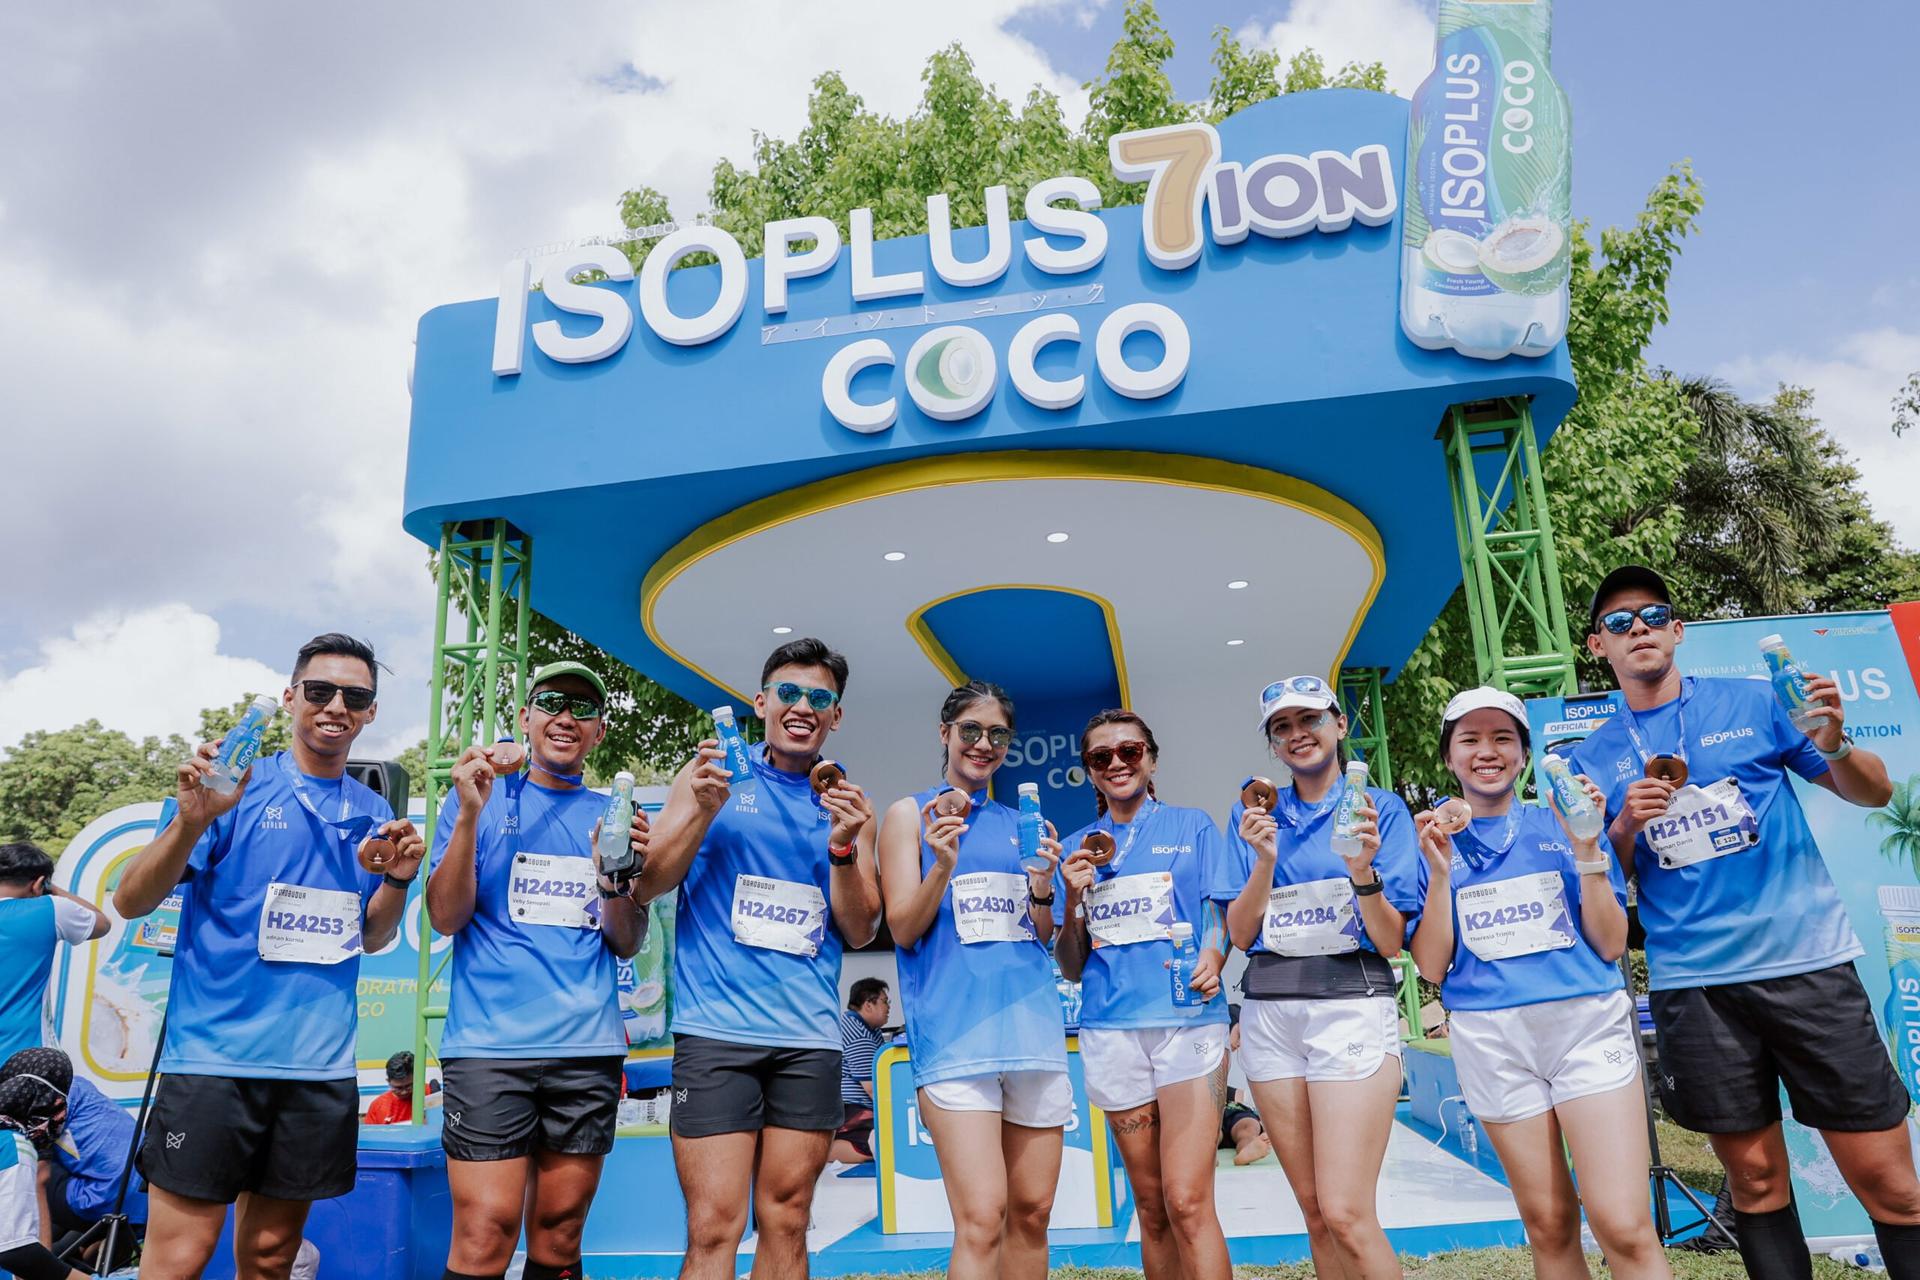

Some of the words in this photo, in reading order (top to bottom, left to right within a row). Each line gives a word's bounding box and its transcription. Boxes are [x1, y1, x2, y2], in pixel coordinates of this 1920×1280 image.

[1502, 60, 1535, 154] COCO
[1440, 53, 1486, 218] ISOPLUS
[492, 177, 1108, 376] ISOPLUS
[822, 303, 1190, 433] COCO
[1565, 703, 1617, 719] ISOPLUS
[1550, 722, 1589, 732] OFFICIAL
[1701, 727, 1754, 748] ISOPLUS
[1844, 724, 1903, 739] RATION
[729, 736, 749, 776] ISOPLUS
[1003, 734, 1082, 768] SOPL
[1649, 803, 1729, 841] H21151
[513, 877, 586, 899] H24232
[1460, 887, 1497, 900] BOROBUDUR
[738, 899, 810, 926] H24267
[958, 896, 1015, 914] K24320
[1089, 896, 1153, 922] K24273
[1269, 906, 1337, 929] K24284
[1464, 901, 1545, 932] K24259
[267, 910, 344, 936] H24253
[1174, 958, 1185, 1001] ISOPLUS
